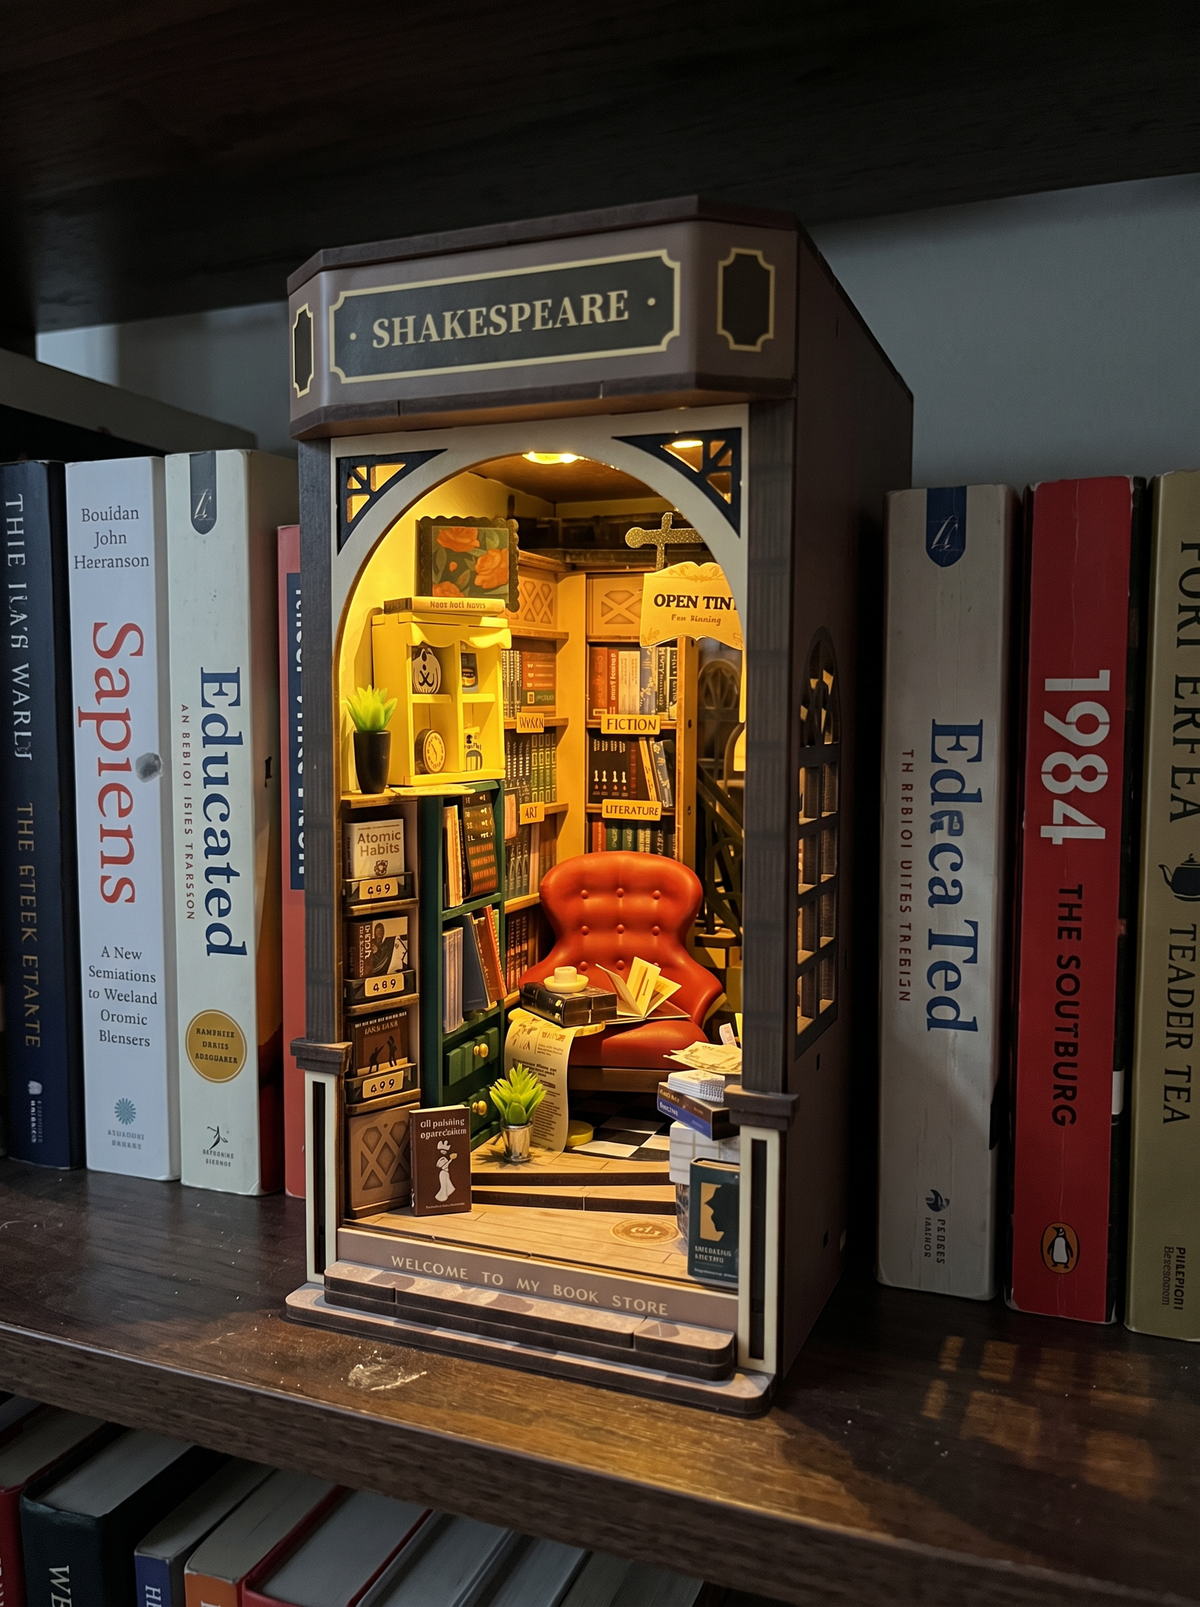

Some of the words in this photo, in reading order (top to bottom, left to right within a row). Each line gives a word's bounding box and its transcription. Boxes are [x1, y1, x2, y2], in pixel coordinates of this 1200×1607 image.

[371, 290, 630, 350] SHAKESPEARE
[80, 504, 140, 523] Bouidan
[93, 530, 128, 550] John
[653, 593, 700, 609] OPEN
[702, 596, 738, 610] TIN
[181, 704, 190, 723] AN
[606, 717, 657, 732] FICTION
[77, 621, 146, 904] Sapiens
[1040, 669, 1111, 845] 1984
[199, 666, 248, 957] Educated
[524, 806, 538, 819] ART
[604, 803, 660, 817] LITERATURE
[16, 801, 34, 851] THE
[357, 830, 401, 844] Atomic
[360, 843, 400, 857] Habits
[1057, 883, 1083, 942] THE
[100, 947, 111, 959] A
[114, 947, 143, 961] New
[88, 965, 157, 984] Semiations
[1165, 923, 1198, 1050] TEADER
[88, 988, 100, 1000] to
[103, 988, 158, 1006] Weeland
[100, 1009, 148, 1026] Oromic
[98, 1029, 151, 1048] Blensers
[1051, 954, 1082, 1127] SOUTBURG
[1162, 1064, 1192, 1125] TEA
[390, 1255, 469, 1280] WELCOME
[481, 1271, 503, 1286] TO
[516, 1278, 540, 1293] MY
[552, 1284, 599, 1304] BOOK
[611, 1295, 669, 1316] STORE
